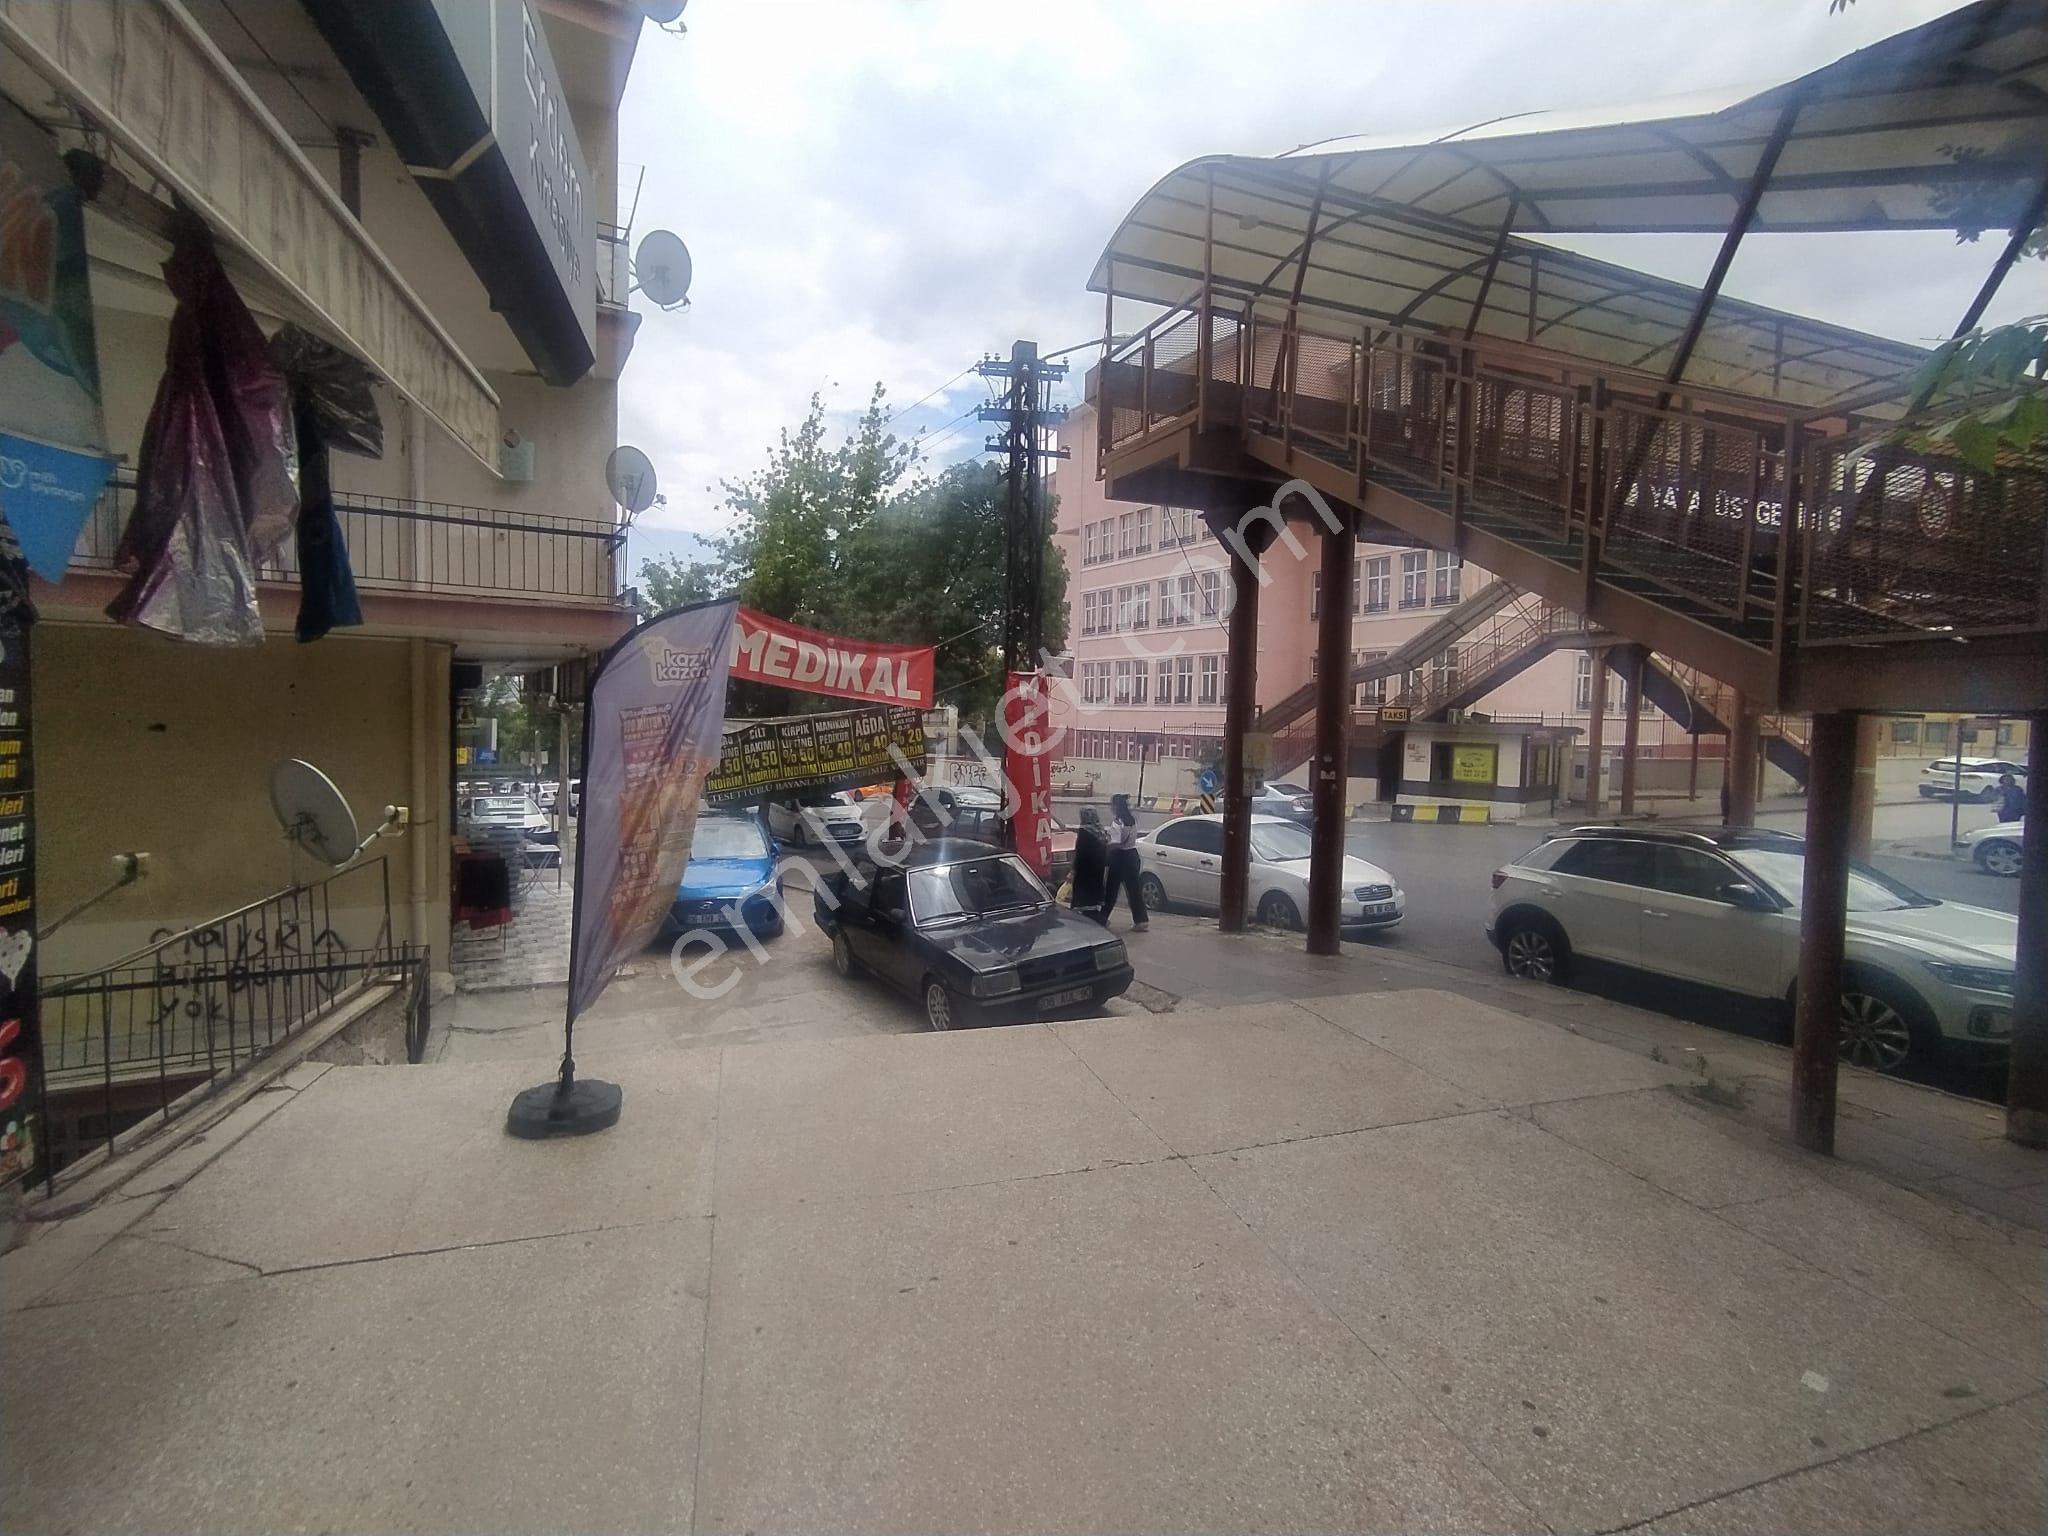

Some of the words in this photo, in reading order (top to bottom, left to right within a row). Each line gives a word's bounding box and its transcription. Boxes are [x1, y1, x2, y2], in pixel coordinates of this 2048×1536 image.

[522, 0, 584, 235] Erdem
[1651, 486, 1701, 514] YAA
[1714, 489, 1748, 519] ÜS
[730, 623, 922, 701] MEDİKAL
[1383, 710, 1406, 720] TAKSİ
[749, 726, 767, 740] CİLT
[781, 722, 811, 737] KİRPİK
[855, 713, 886, 737] AĞDA
[857, 738, 871, 753] %
[873, 734, 888, 749] 40
[907, 727, 923, 743] 20
[745, 754, 760, 769] %
[762, 750, 778, 766] 50
[783, 748, 797, 763] %
[799, 748, 815, 762] 50
[820, 745, 834, 760] %
[837, 741, 852, 756] 40
[725, 758, 741, 774] 50
[1019, 676, 1051, 866] MEDİKAL
